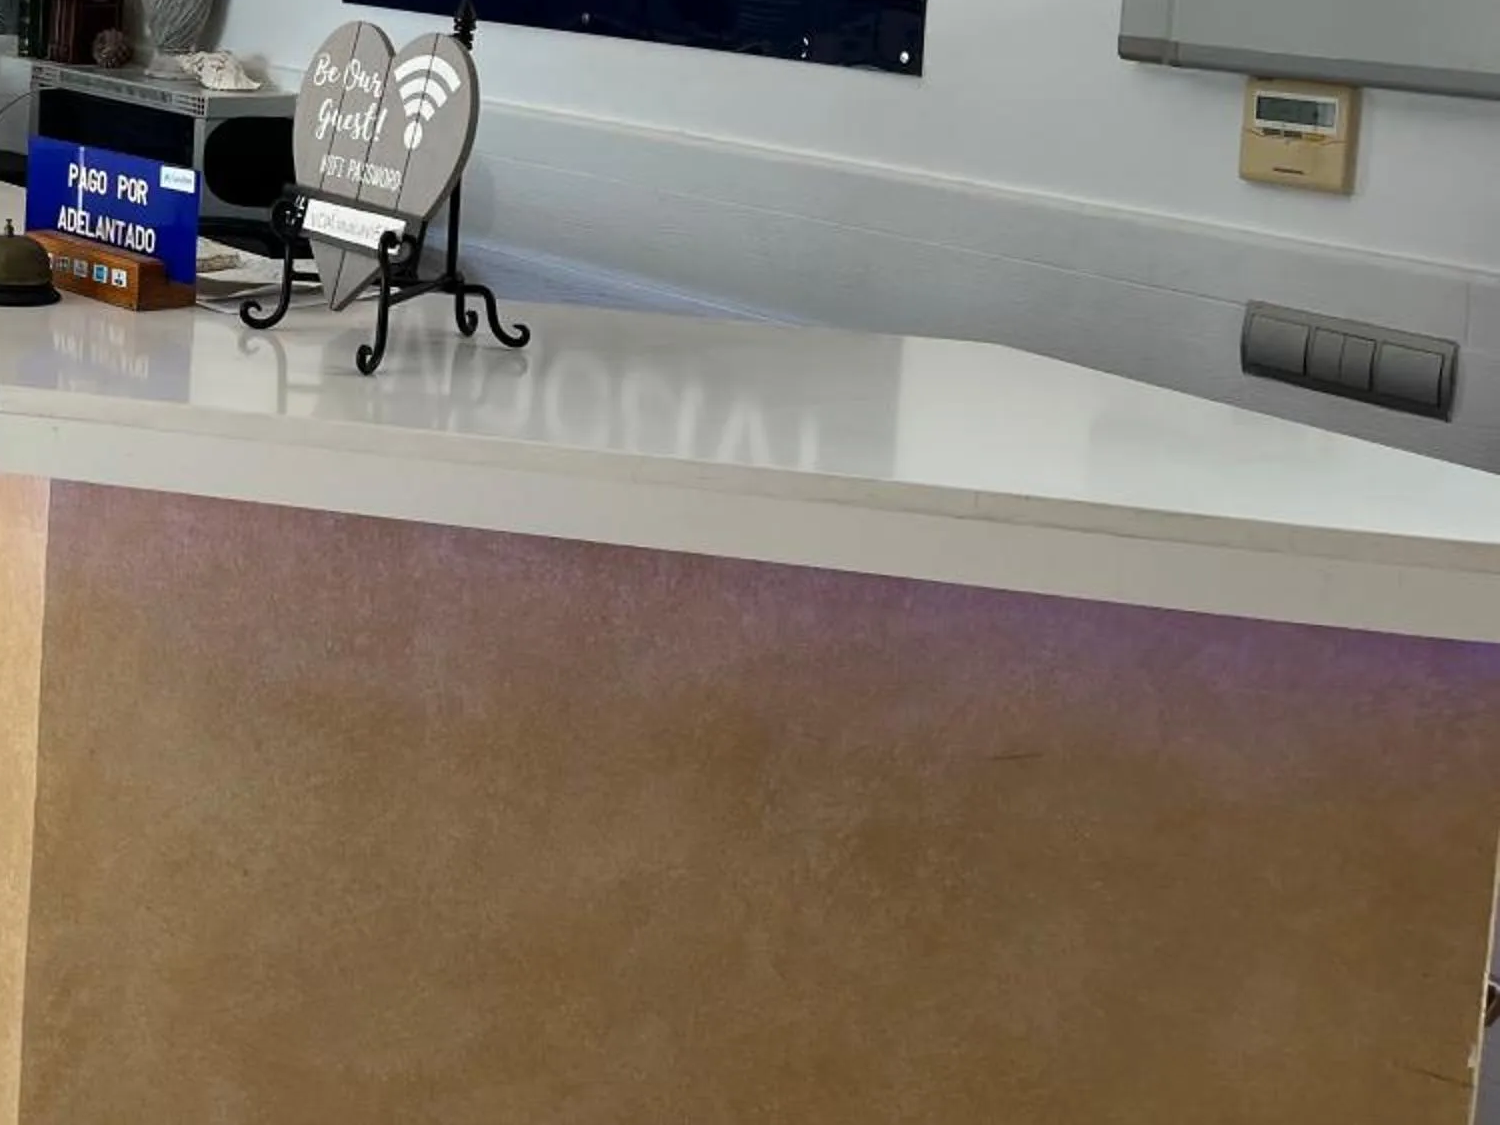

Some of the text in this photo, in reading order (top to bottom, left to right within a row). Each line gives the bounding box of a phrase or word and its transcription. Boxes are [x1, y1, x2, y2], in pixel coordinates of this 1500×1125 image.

[313, 52, 384, 99] Be Our
[315, 98, 388, 143] Guest!
[67, 162, 108, 196] PAGO
[116, 174, 149, 206] POR
[57, 204, 157, 254] ADELANTADO
